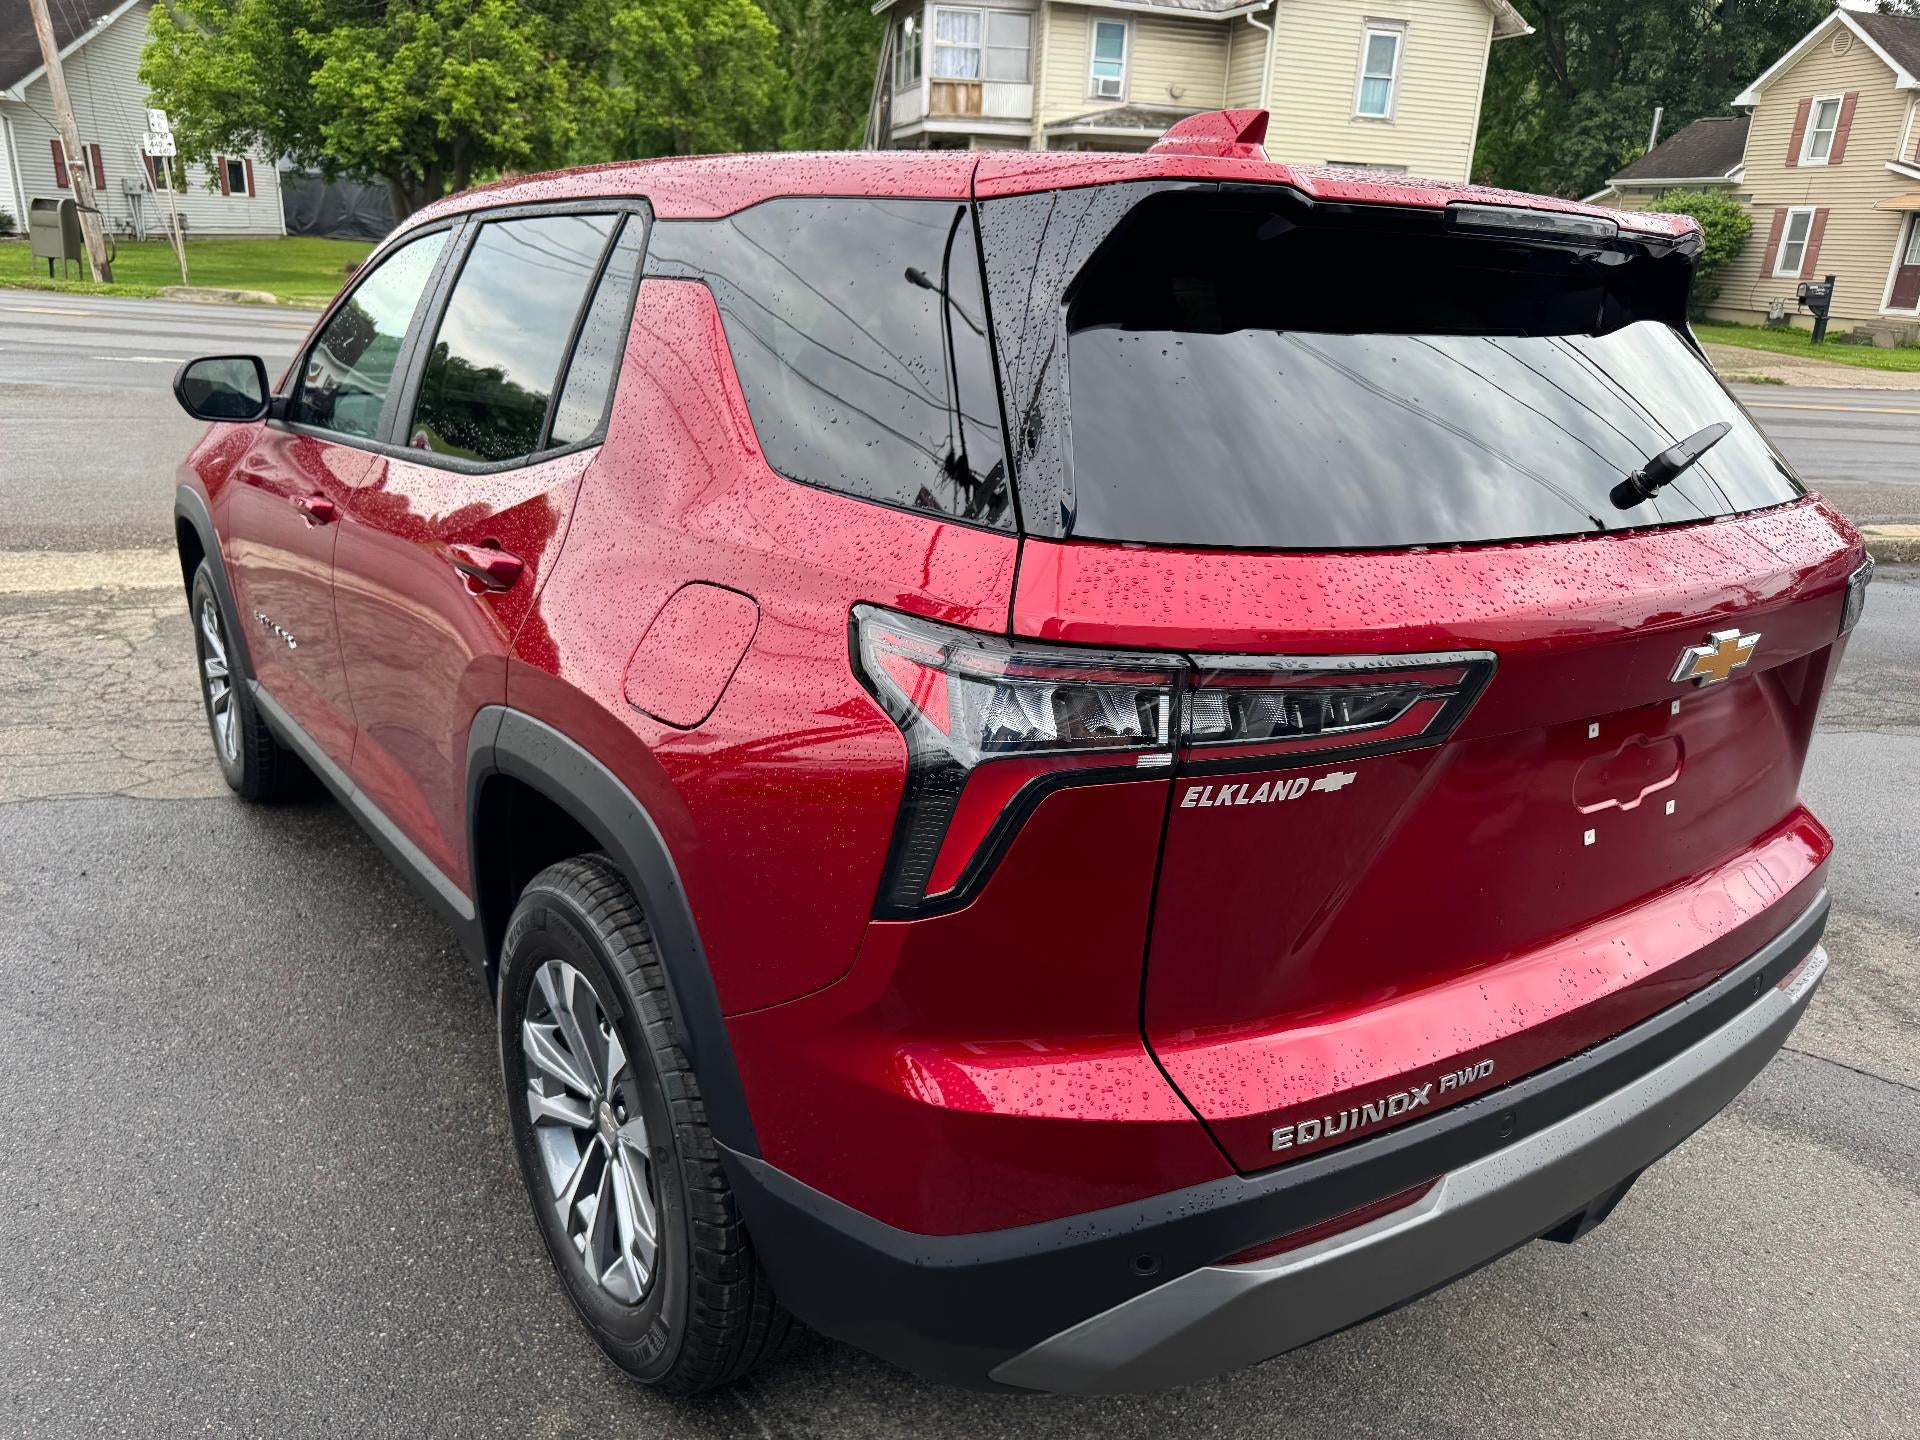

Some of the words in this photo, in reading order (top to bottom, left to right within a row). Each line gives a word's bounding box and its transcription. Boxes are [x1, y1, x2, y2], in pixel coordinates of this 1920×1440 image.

[1180, 777, 1310, 807] ELKLAND
[1272, 1082, 1432, 1151] EQUINOX
[1439, 1059, 1494, 1094] AWD
